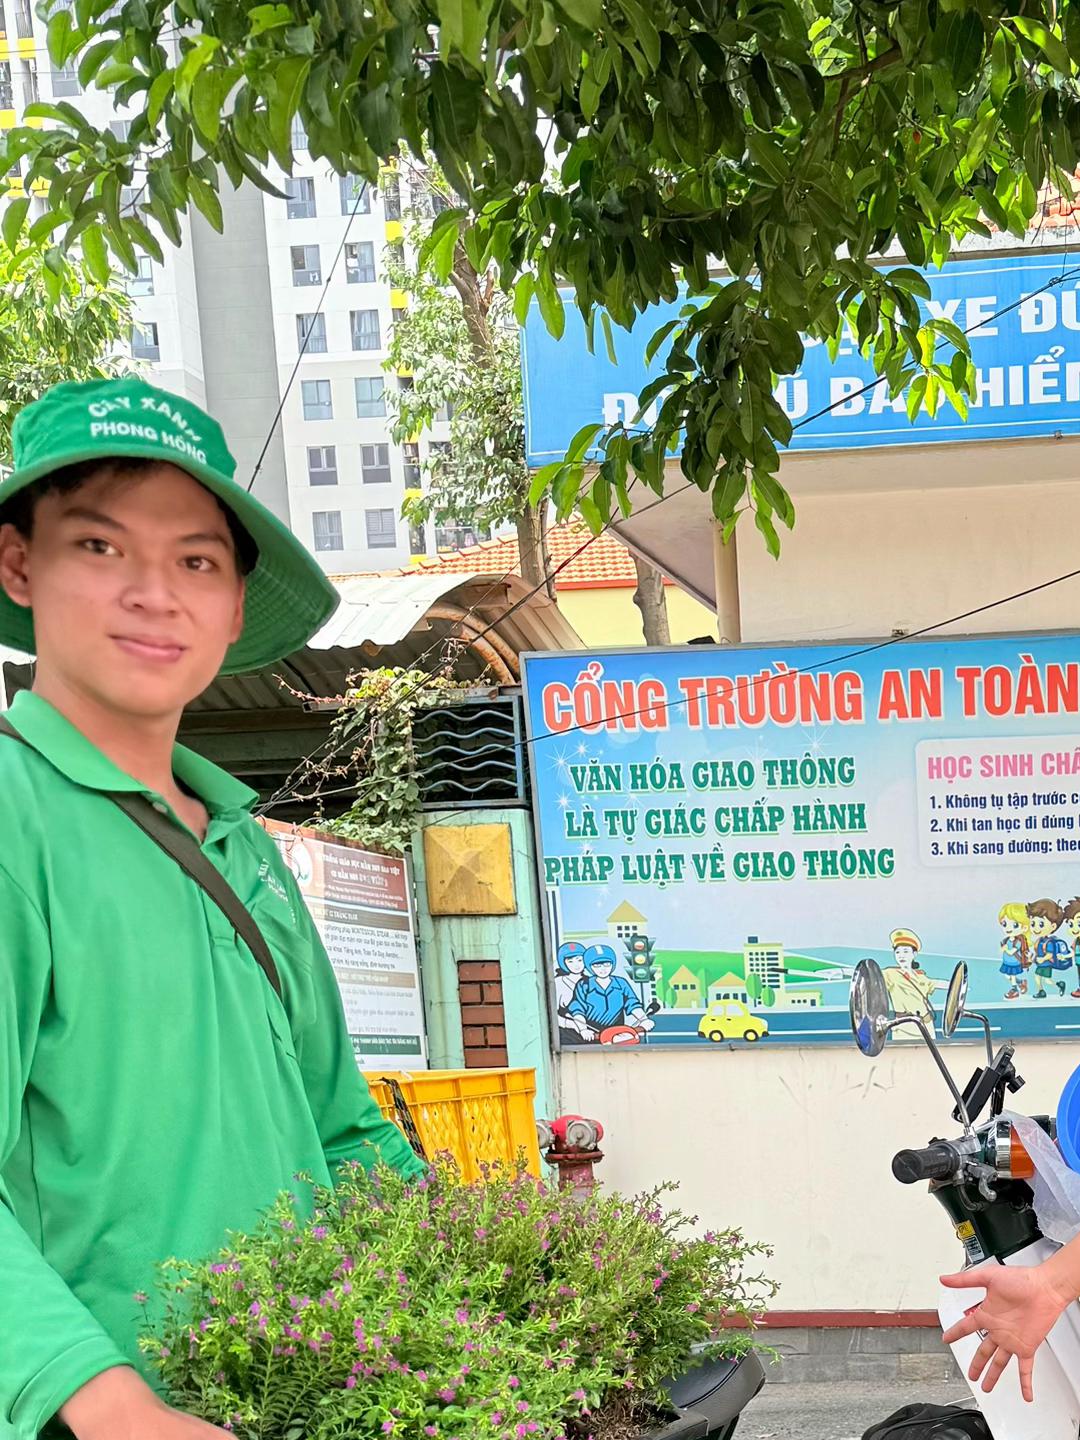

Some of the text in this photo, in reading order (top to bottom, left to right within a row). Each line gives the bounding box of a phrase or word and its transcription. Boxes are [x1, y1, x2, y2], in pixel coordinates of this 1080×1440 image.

[90, 422, 158, 440] PHONG
[544, 662, 667, 732] CỔNG
[680, 662, 863, 727] TRƯỜNG
[878, 668, 942, 720] AN
[956, 655, 1079, 716] TOÀN
[570, 752, 855, 792] VĂN HÓA GIAO THÔNG
[928, 756, 972, 784] HỌC
[980, 753, 1033, 778] SINH
[930, 795, 942, 809] 1.
[945, 794, 987, 810] Không
[991, 794, 1003, 810] tụ
[1008, 792, 1028, 810] tập
[1032, 790, 1067, 806] trước
[565, 796, 867, 842] LÀ TỰ GIÁC CHẤP HÀNH
[930, 818, 942, 833] 2.
[946, 817, 967, 832] Khi
[972, 818, 992, 831] tan
[997, 816, 1021, 833] học
[1025, 815, 1037, 829] đi
[1042, 814, 1074, 830] đúng
[931, 842, 943, 856] 3.
[947, 841, 968, 855] Khi
[973, 843, 1004, 855] sang
[1008, 839, 1052, 854] đường:
[545, 842, 895, 887] PHÁP LUẬT VỀ GIAO THÔNG
